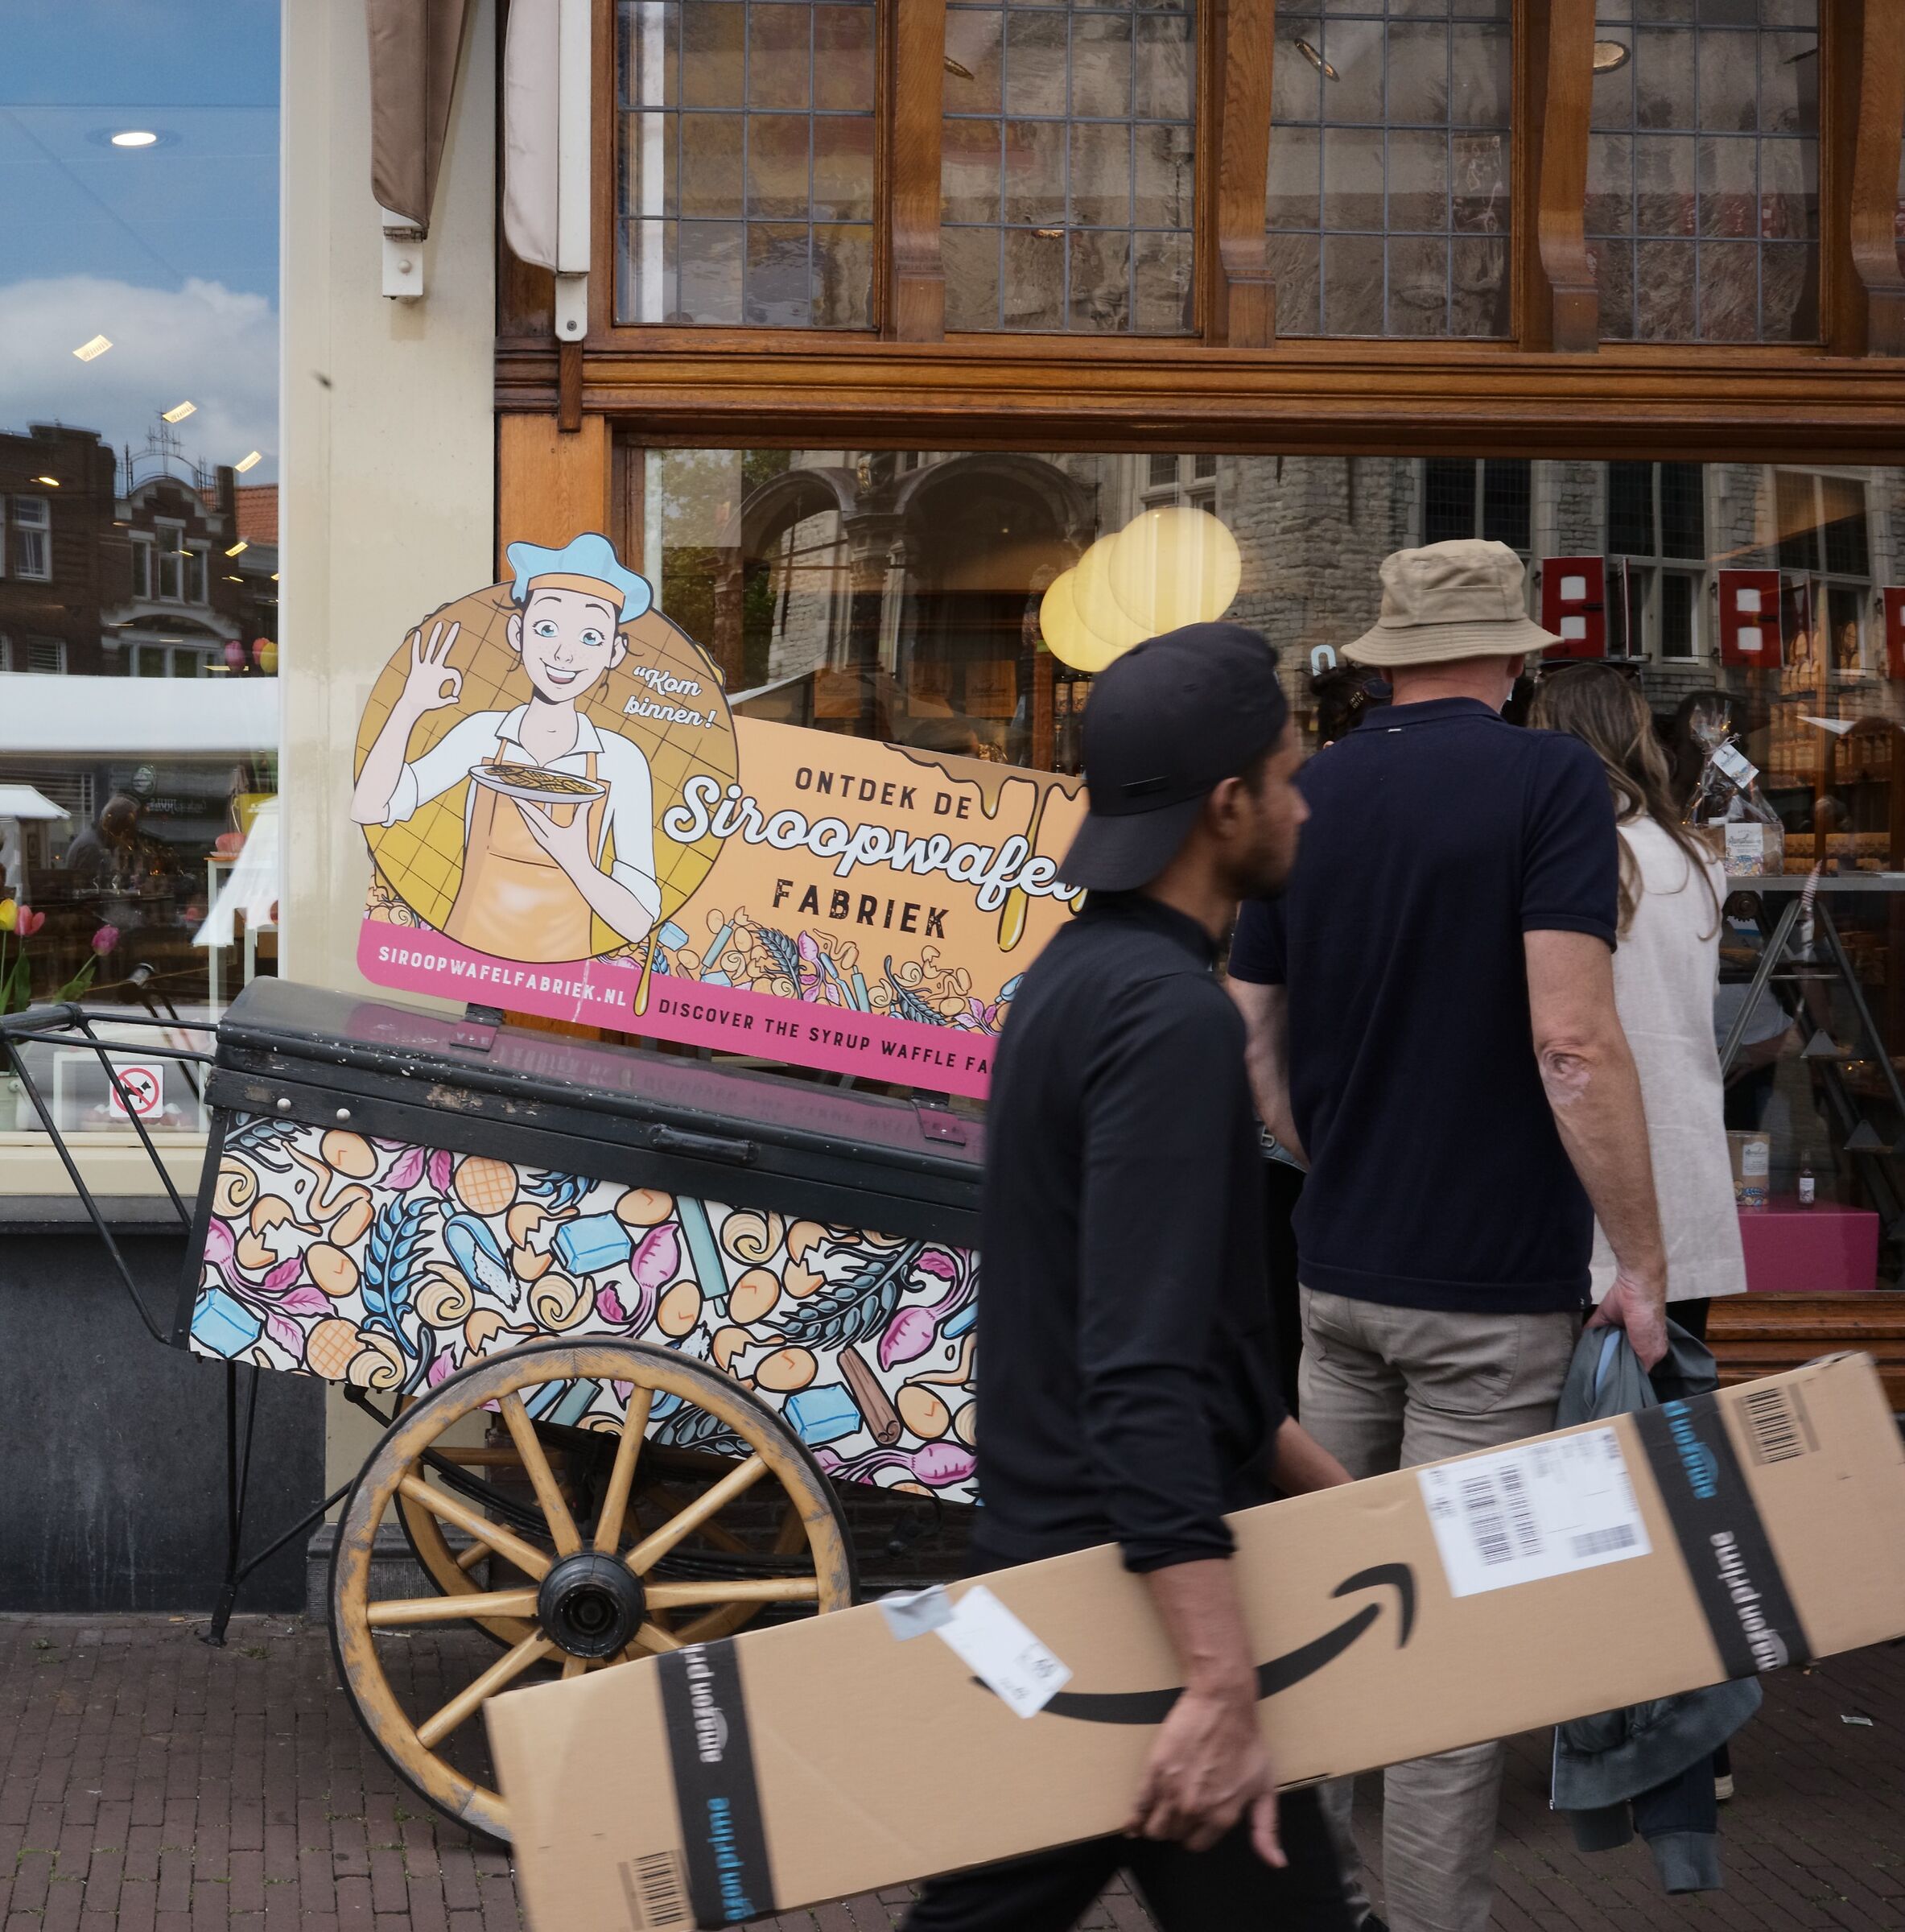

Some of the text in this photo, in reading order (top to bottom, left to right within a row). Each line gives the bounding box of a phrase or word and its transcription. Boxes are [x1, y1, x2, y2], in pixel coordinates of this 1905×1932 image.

[794, 766, 972, 819] ONTDEK DE
[772, 877, 950, 939] FABRIEK
[377, 945, 627, 1006] SIROOPWAFELFABRIEK.NL
[658, 998, 989, 1075] DISCOVER THE SYRUP WAFFLE FA
[1737, 1604, 1787, 1673] mazon
[688, 1681, 728, 1763] amazon
[707, 1797, 745, 1869] prime
